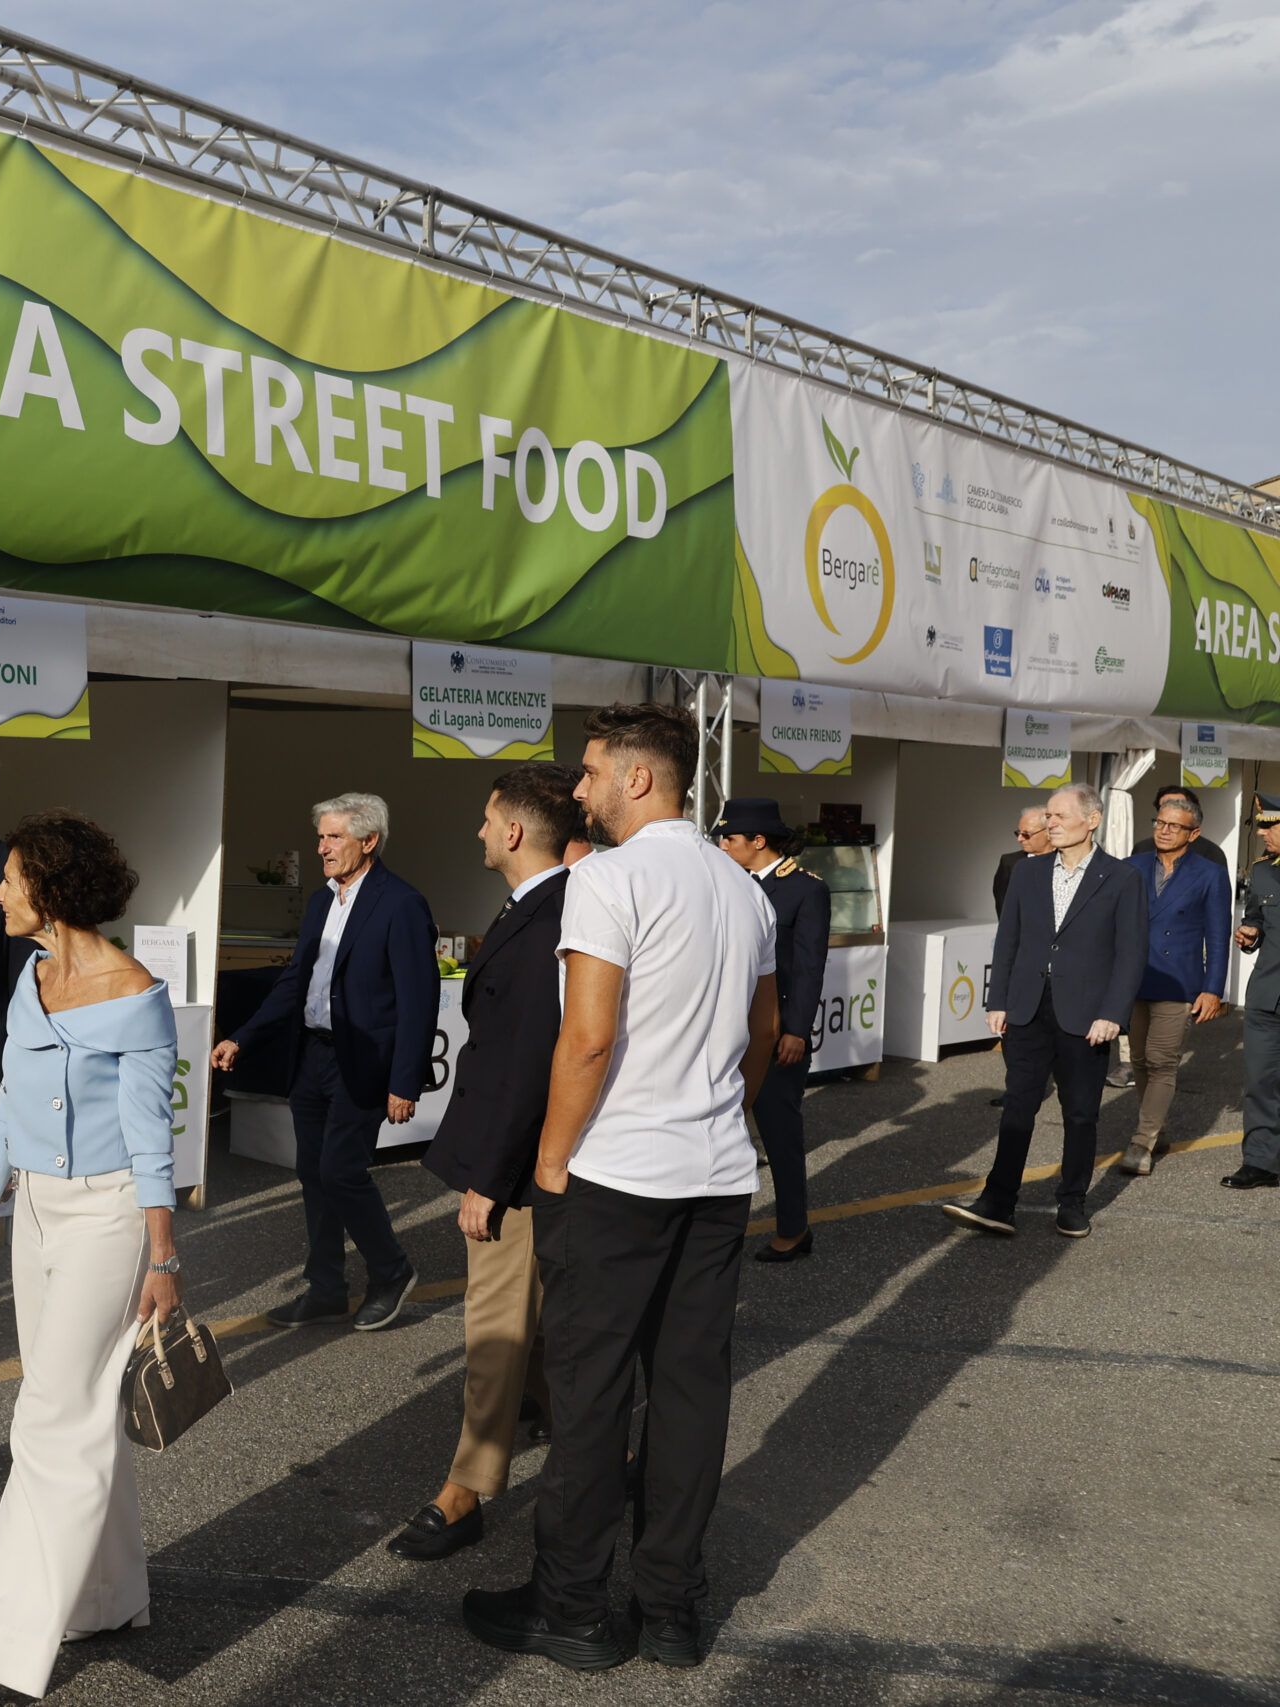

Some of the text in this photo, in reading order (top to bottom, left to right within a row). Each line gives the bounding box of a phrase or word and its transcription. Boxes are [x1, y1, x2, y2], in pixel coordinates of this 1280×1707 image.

[121, 327, 454, 499] STREET
[479, 411, 668, 540] FOOD
[822, 547, 880, 590] Bergarè
[1034, 577, 1051, 594] CNA
[1194, 596, 1262, 662] AREA
[419, 686, 547, 708] GELATERIA MCKENZYE
[429, 709, 542, 731] di Laganà Domenico
[772, 726, 842, 743] CHICKEN FRIENDS
